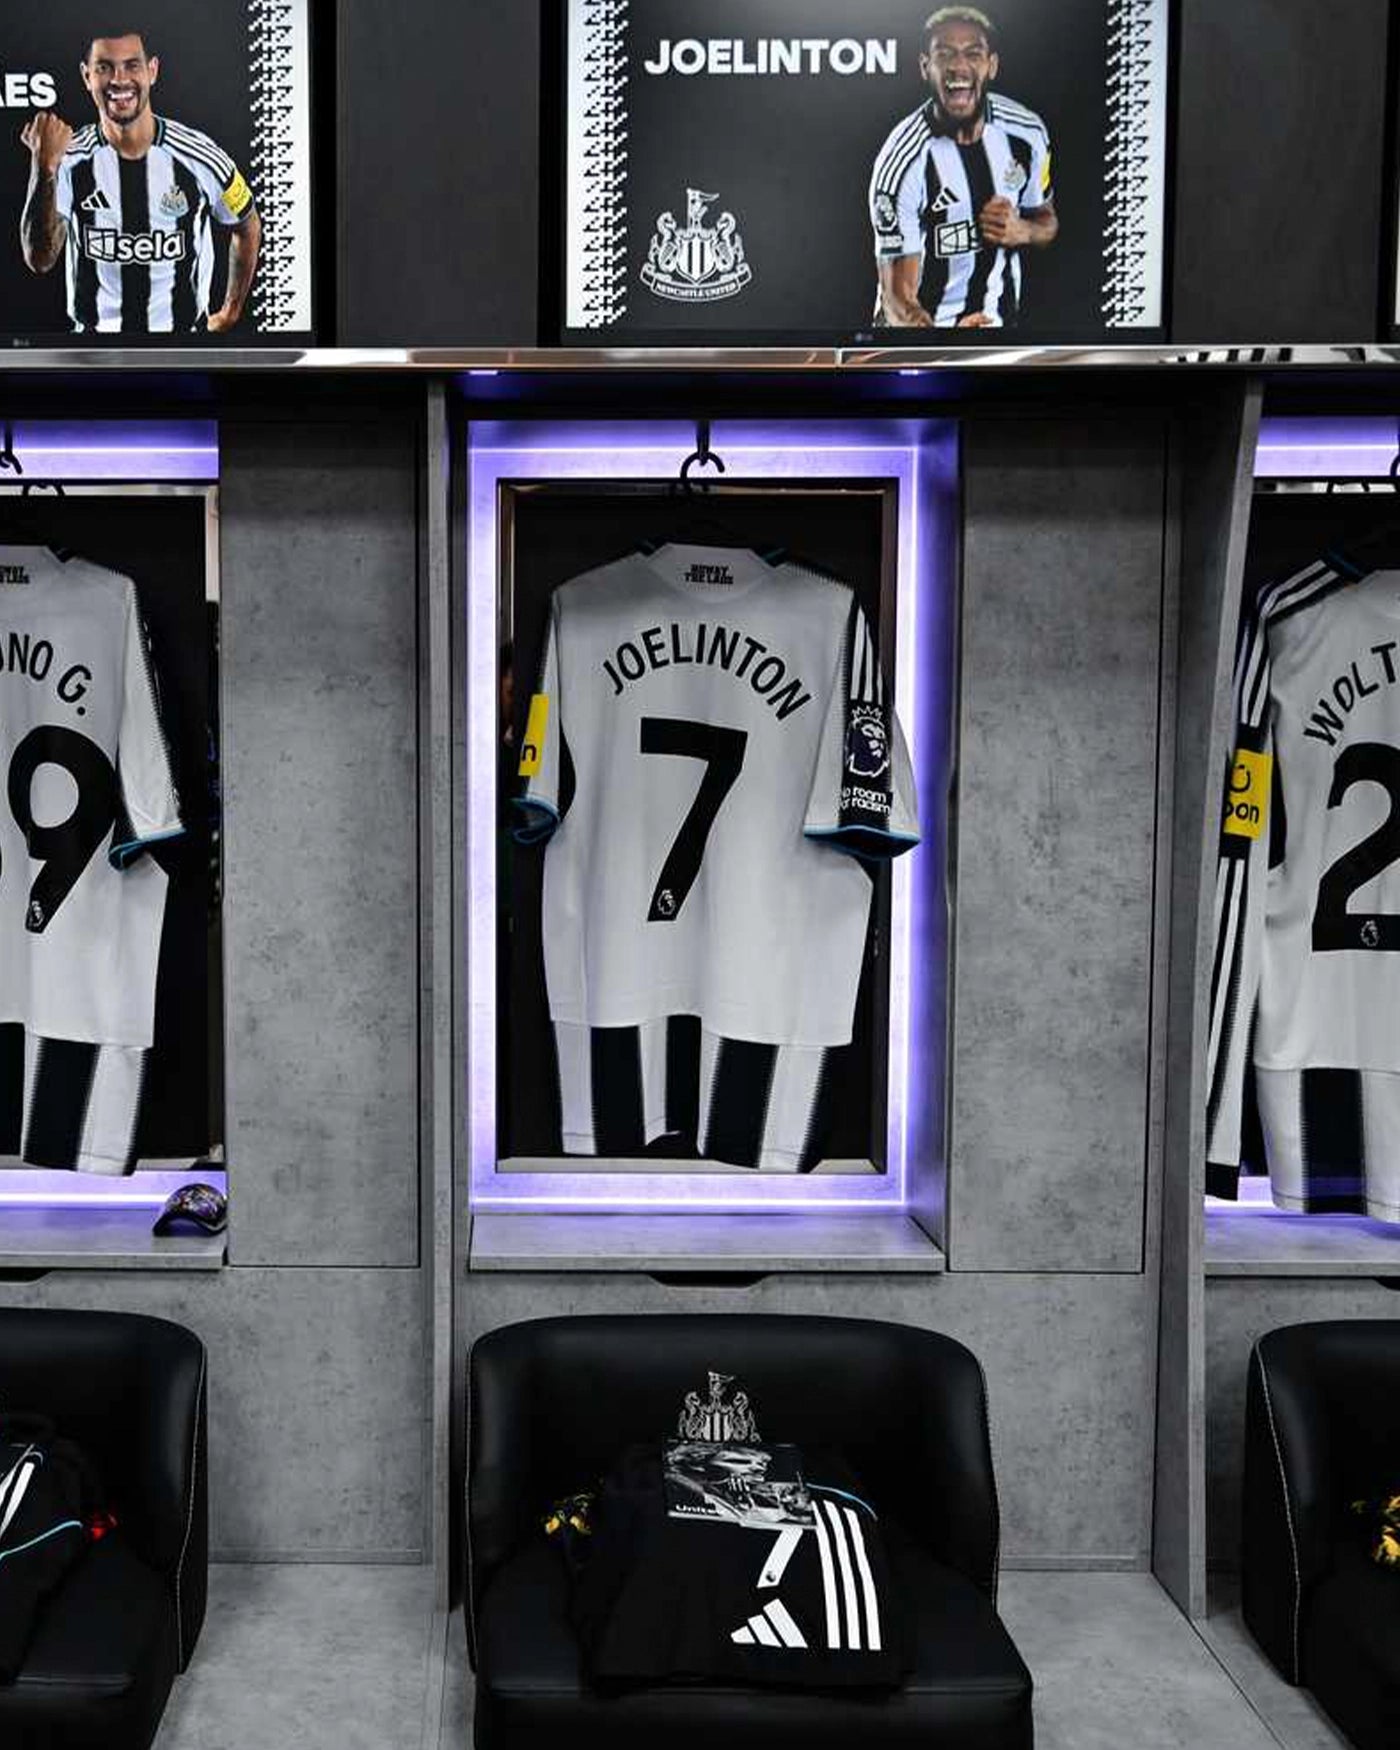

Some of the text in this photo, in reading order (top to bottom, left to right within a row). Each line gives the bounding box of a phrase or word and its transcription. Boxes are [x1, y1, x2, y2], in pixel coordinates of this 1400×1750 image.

[0, 72, 57, 107] ES
[644, 38, 898, 75] JOELINTON
[117, 232, 181, 259] sela
[0, 632, 92, 716] NO G.
[603, 623, 812, 722] JOELINTON
[1303, 642, 1397, 747] WOLT
[0, 725, 117, 934] 9
[640, 717, 748, 922] 7
[853, 787, 886, 803] room
[1311, 742, 1400, 952] 2
